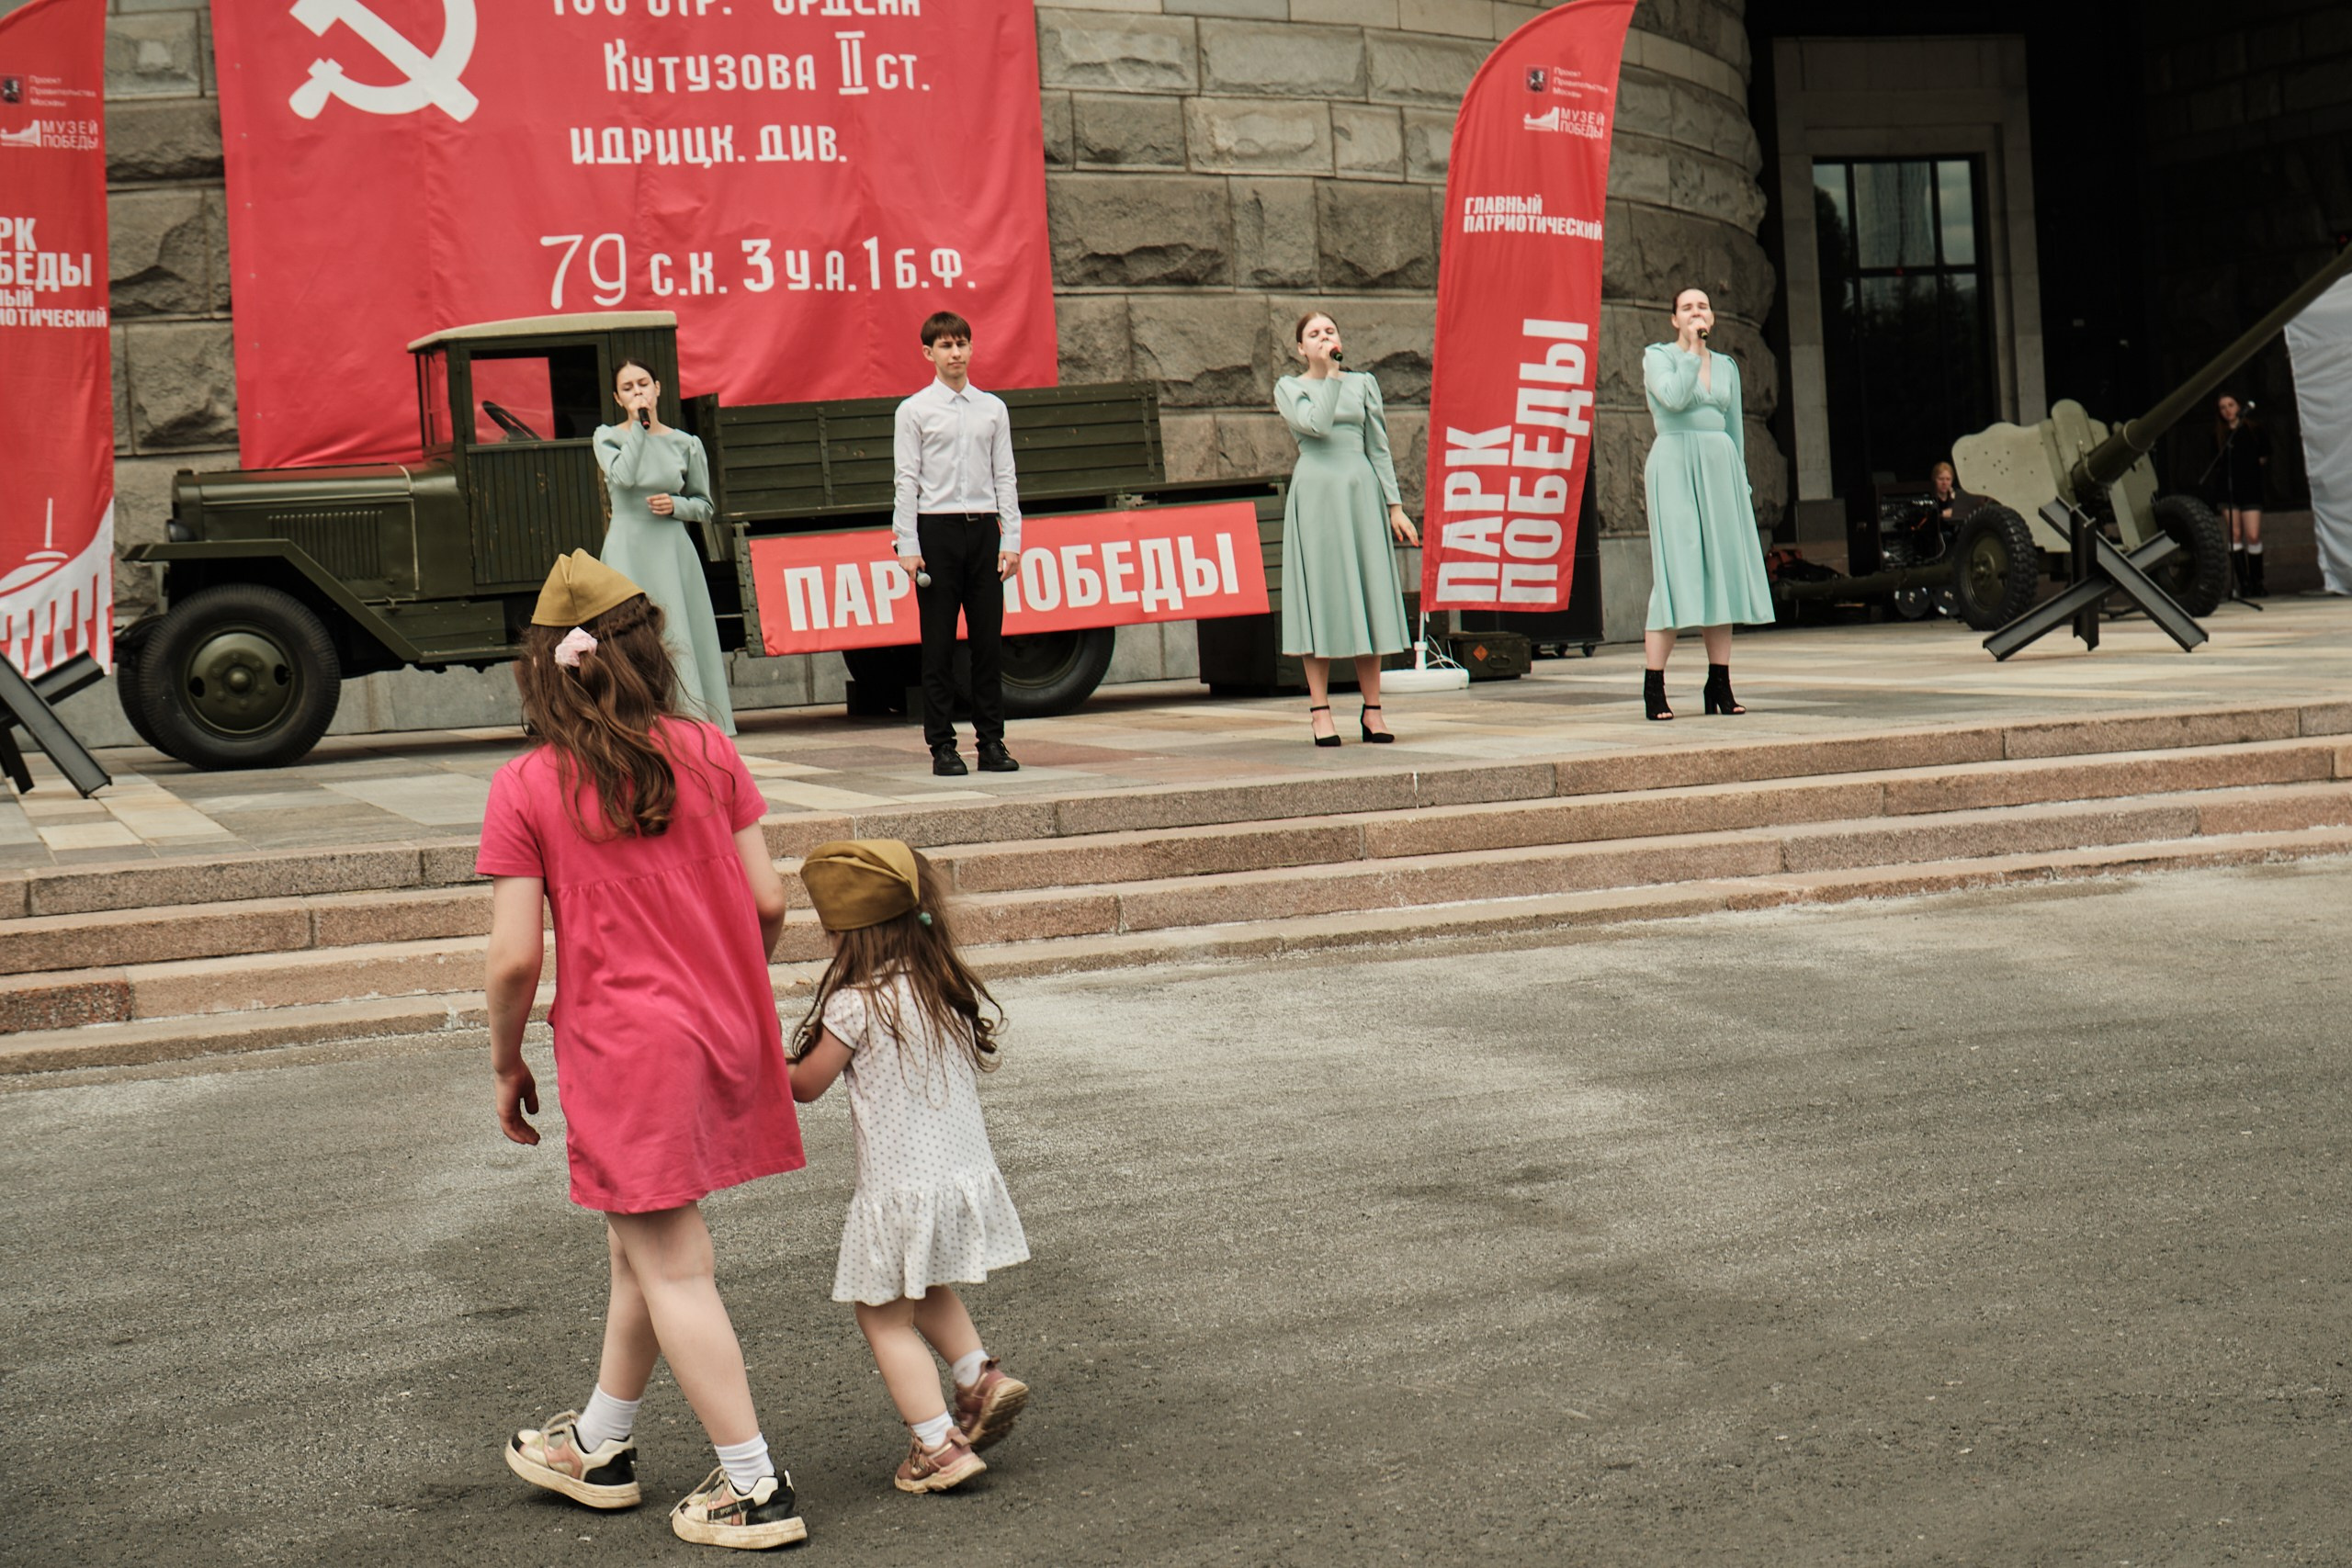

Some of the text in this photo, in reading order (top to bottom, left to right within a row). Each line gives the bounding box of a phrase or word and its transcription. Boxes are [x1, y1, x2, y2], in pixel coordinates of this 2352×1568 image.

[41, 119, 98, 135] МУЗЕЙ
[1561, 107, 1605, 127] МУЗЕЙ
[1560, 119, 1604, 140] ПОБЕДЫ
[42, 133, 98, 151] ПОБЕДЫ
[1464, 193, 1543, 215] ГЛАВНЫЙ
[1464, 214, 1602, 241] ПАТРИОТИЧЕСКИЙ
[539, 232, 628, 310] 79
[1499, 318, 1594, 604] ПОБЕДЫ
[1436, 425, 1512, 603] ПАРК
[783, 560, 910, 632] ПАР
